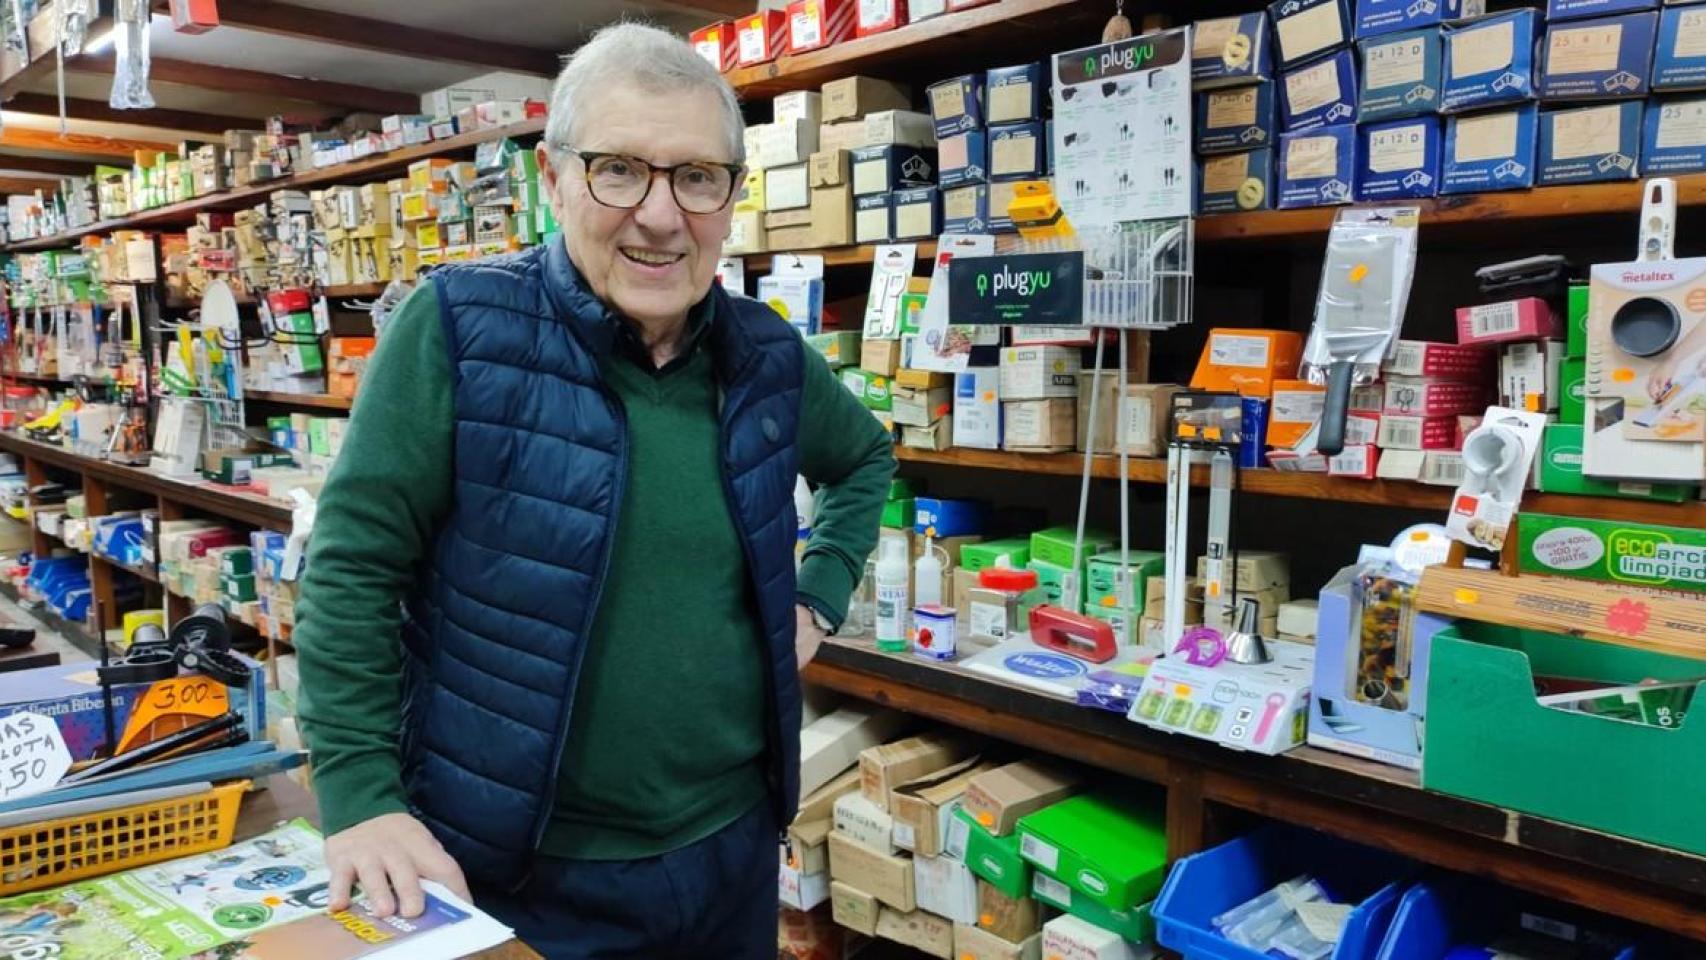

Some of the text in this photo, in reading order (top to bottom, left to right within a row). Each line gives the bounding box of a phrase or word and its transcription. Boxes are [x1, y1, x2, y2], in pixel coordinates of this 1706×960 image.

[1101, 43, 1154, 75] plugyu
[993, 264, 1051, 297] plugyu
[1621, 271, 1675, 283] metaltex
[0, 717, 36, 745] AS
